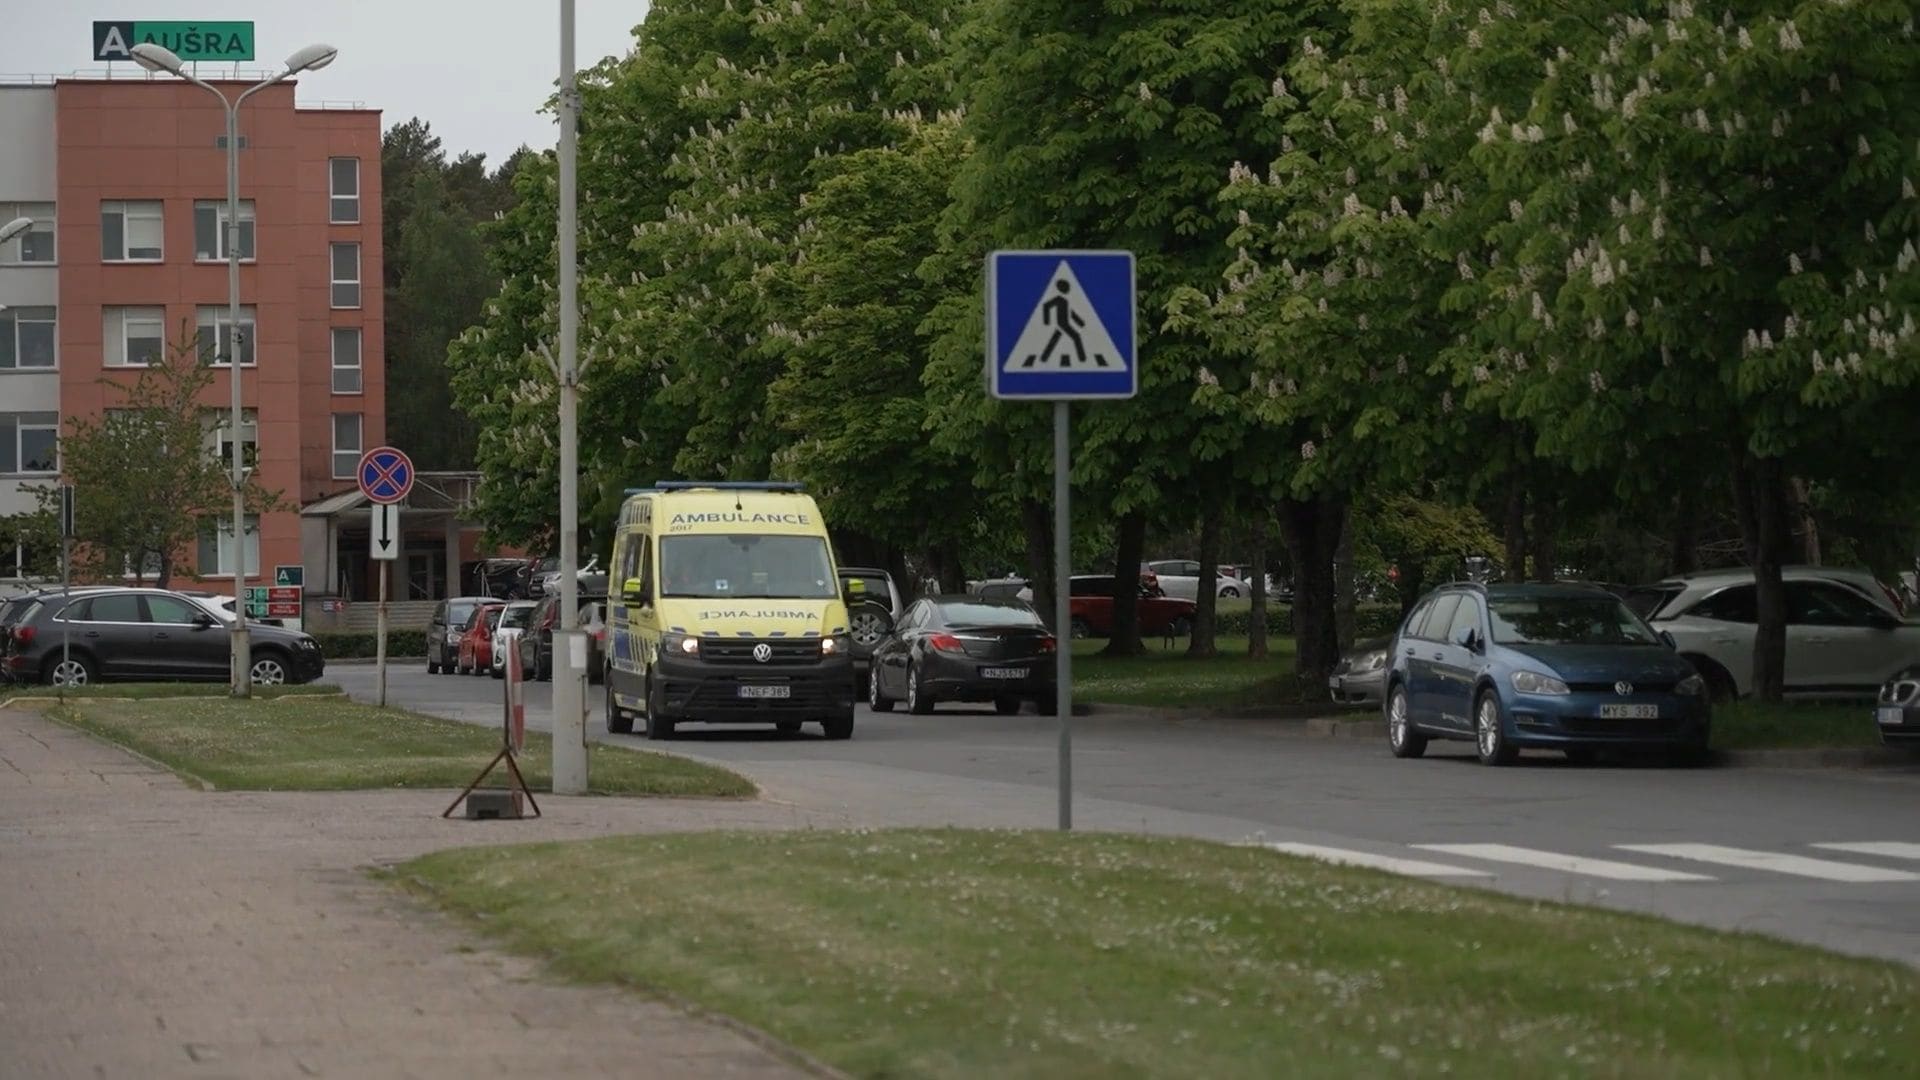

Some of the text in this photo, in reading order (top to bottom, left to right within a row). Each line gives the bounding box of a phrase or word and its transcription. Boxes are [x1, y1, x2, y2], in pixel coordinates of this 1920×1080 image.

[99, 26, 130, 56] A
[672, 513, 810, 525] AMBULANCE
[1602, 706, 1657, 718] MYS 392
